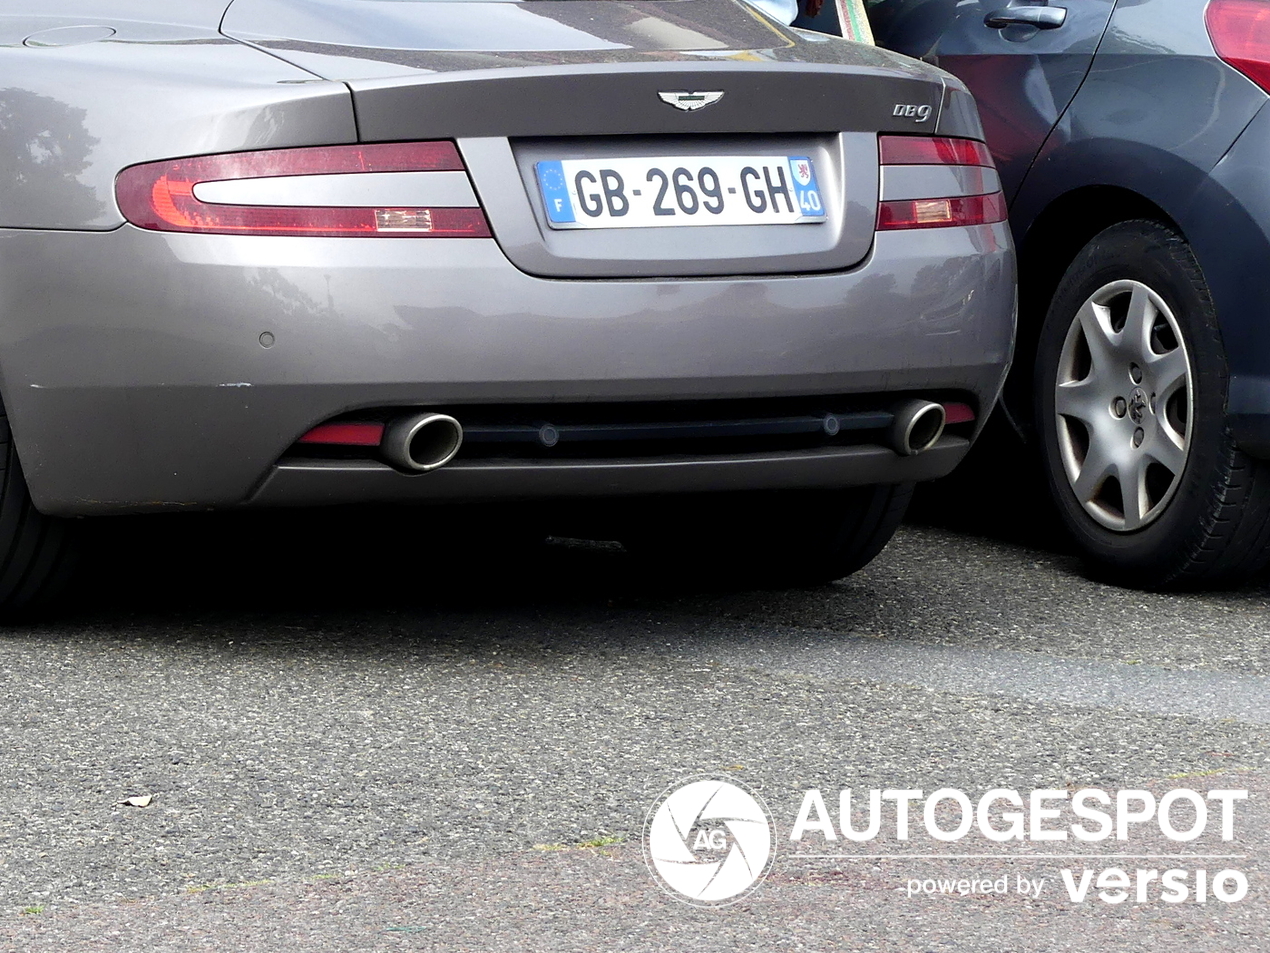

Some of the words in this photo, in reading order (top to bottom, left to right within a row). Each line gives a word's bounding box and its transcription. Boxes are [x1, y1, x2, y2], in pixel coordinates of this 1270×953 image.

[892, 103, 932, 124] DB9
[554, 197, 563, 213] F
[574, 165, 795, 219] GB-269-GH
[799, 190, 821, 212] 40
